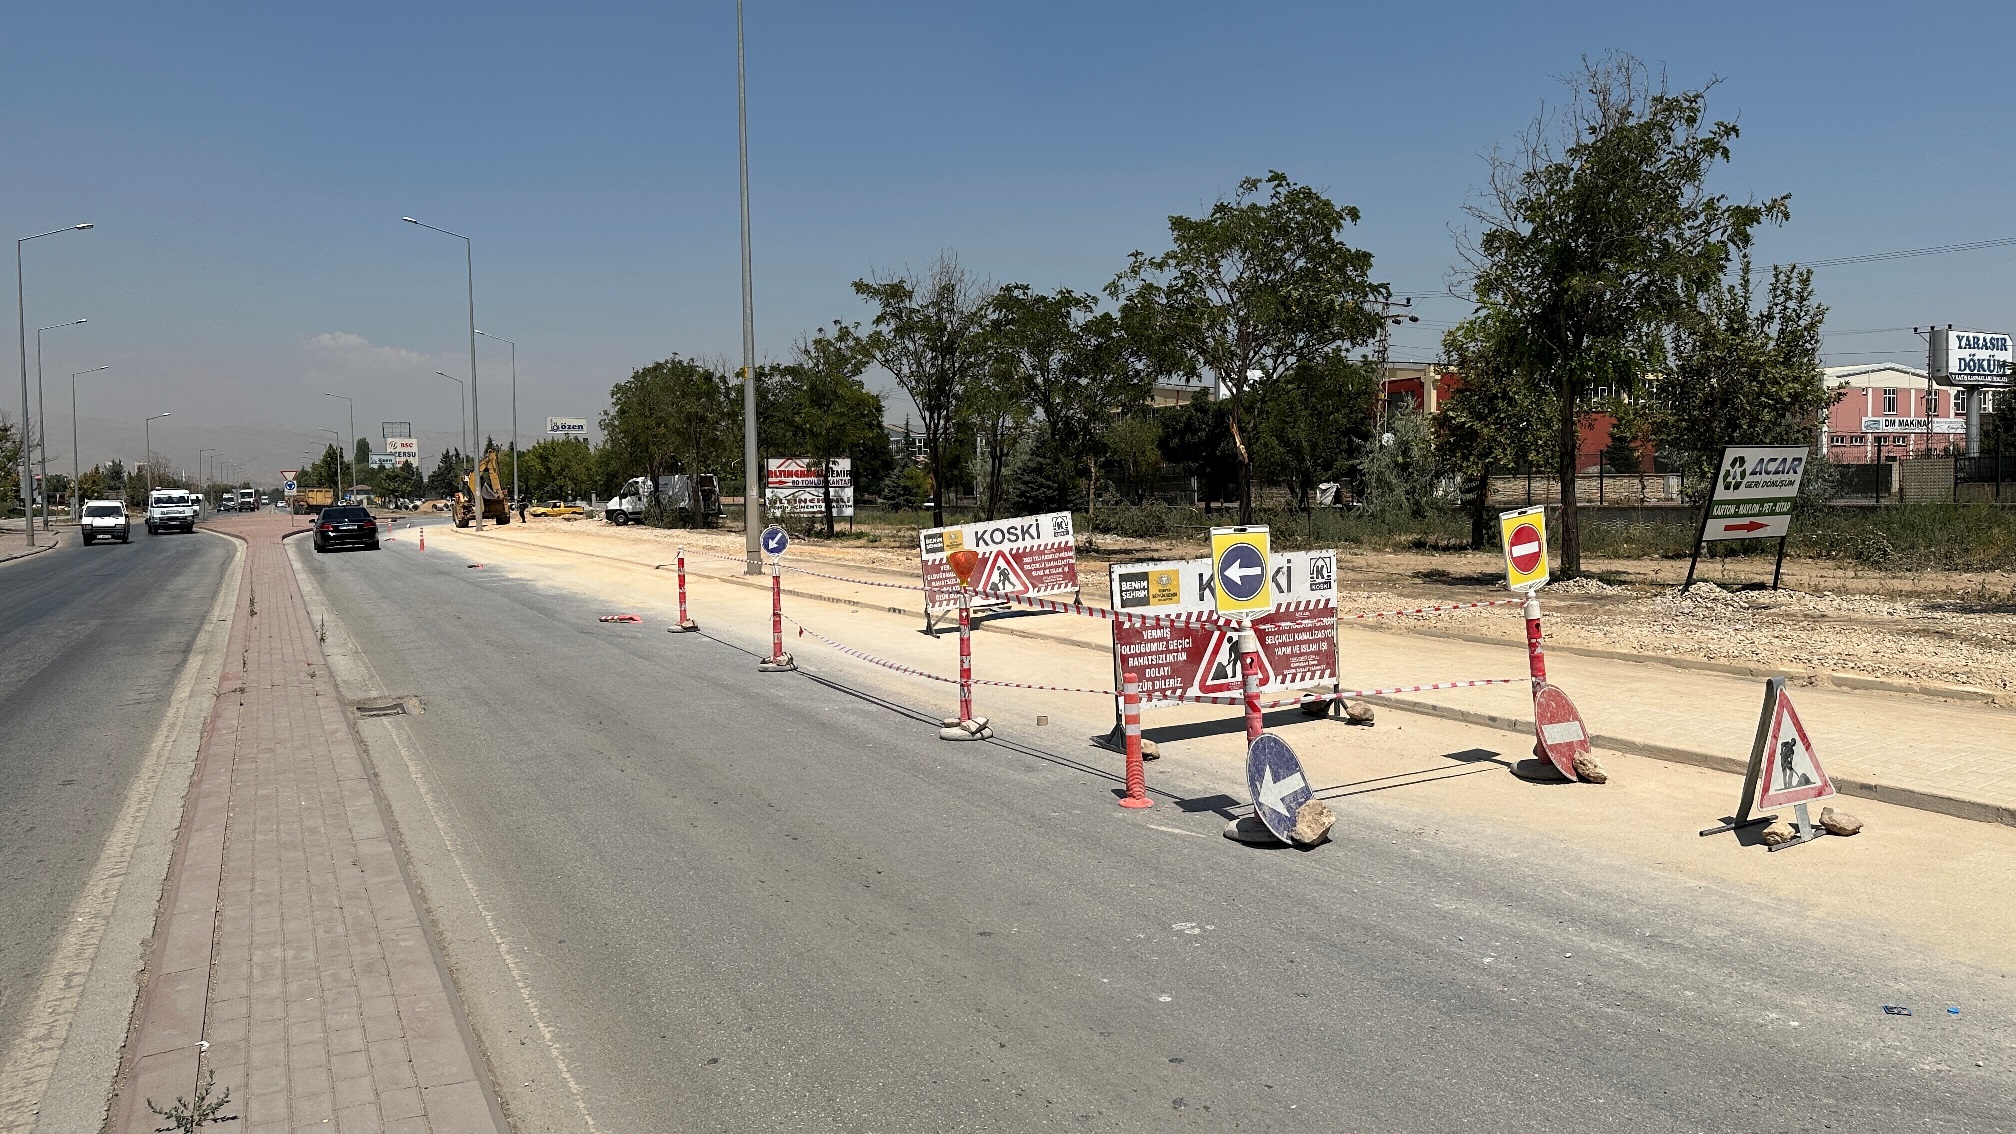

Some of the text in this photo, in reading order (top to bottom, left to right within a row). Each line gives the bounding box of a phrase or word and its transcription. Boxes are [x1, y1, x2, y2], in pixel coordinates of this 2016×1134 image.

[1957, 353, 2007, 374] DÖKÜM
[560, 422, 584, 430] özen
[1884, 418, 1896, 428] DM
[1748, 456, 1803, 476] ACAR
[1744, 477, 1796, 490] GERİ DÖNÜŞÜM
[1712, 500, 1791, 516] KARTON NAYLON PET KİTAP
[974, 519, 1041, 548] KOSKİ
[1121, 580, 1148, 591] BENİM
[1198, 558, 1293, 602] KKİ
[1121, 589, 1148, 601] ŞEHRİM
[1142, 626, 1171, 640] VERMİŞ
[1265, 632, 1294, 646] SELÇUKLU
[1121, 635, 1193, 655] OLDUĞUMUZ GEÇİCİ
[1274, 639, 1328, 656] YAPIM VE ISLAHI İŞİ
[1128, 651, 1187, 667] RAHATSIZLIKTAN
[1145, 666, 1171, 678] DOLAYI
[1138, 676, 1184, 692] ZÜR DİLERİZ.
